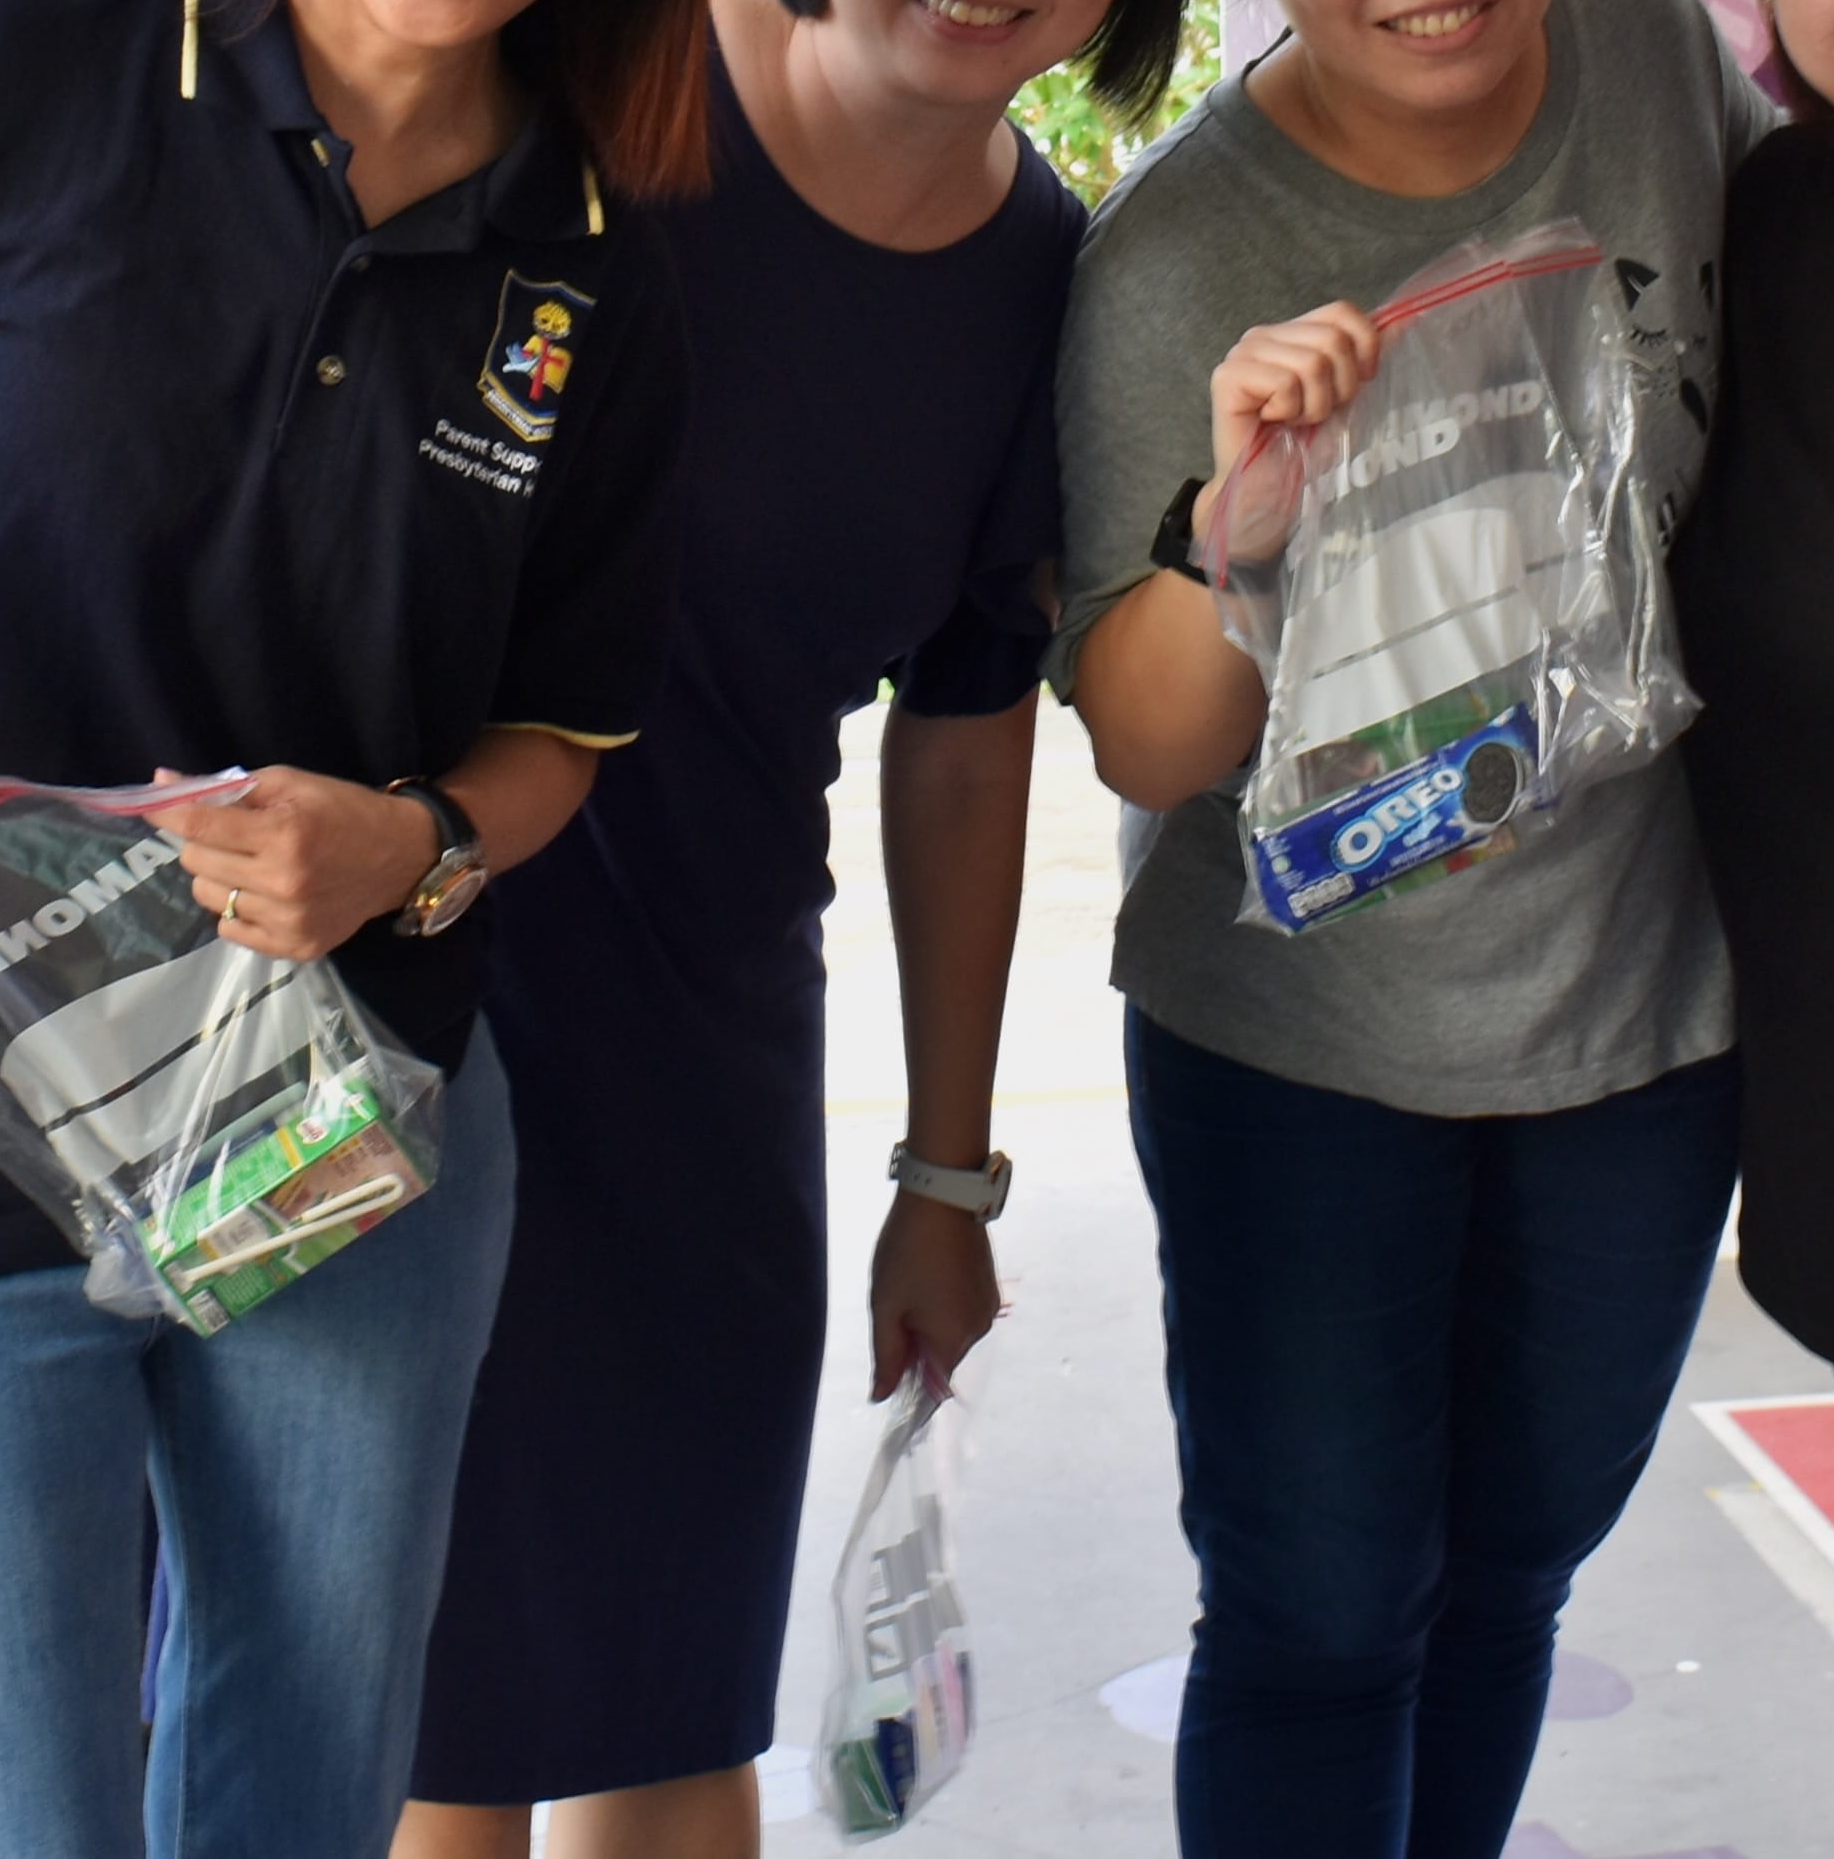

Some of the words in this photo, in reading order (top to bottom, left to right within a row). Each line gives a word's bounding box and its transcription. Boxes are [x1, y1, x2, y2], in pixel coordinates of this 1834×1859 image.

[418, 438, 522, 494] Presbyterian
[434, 418, 491, 456] Parent
[490, 441, 543, 474] Supp
[1336, 768, 1464, 866] OREO
